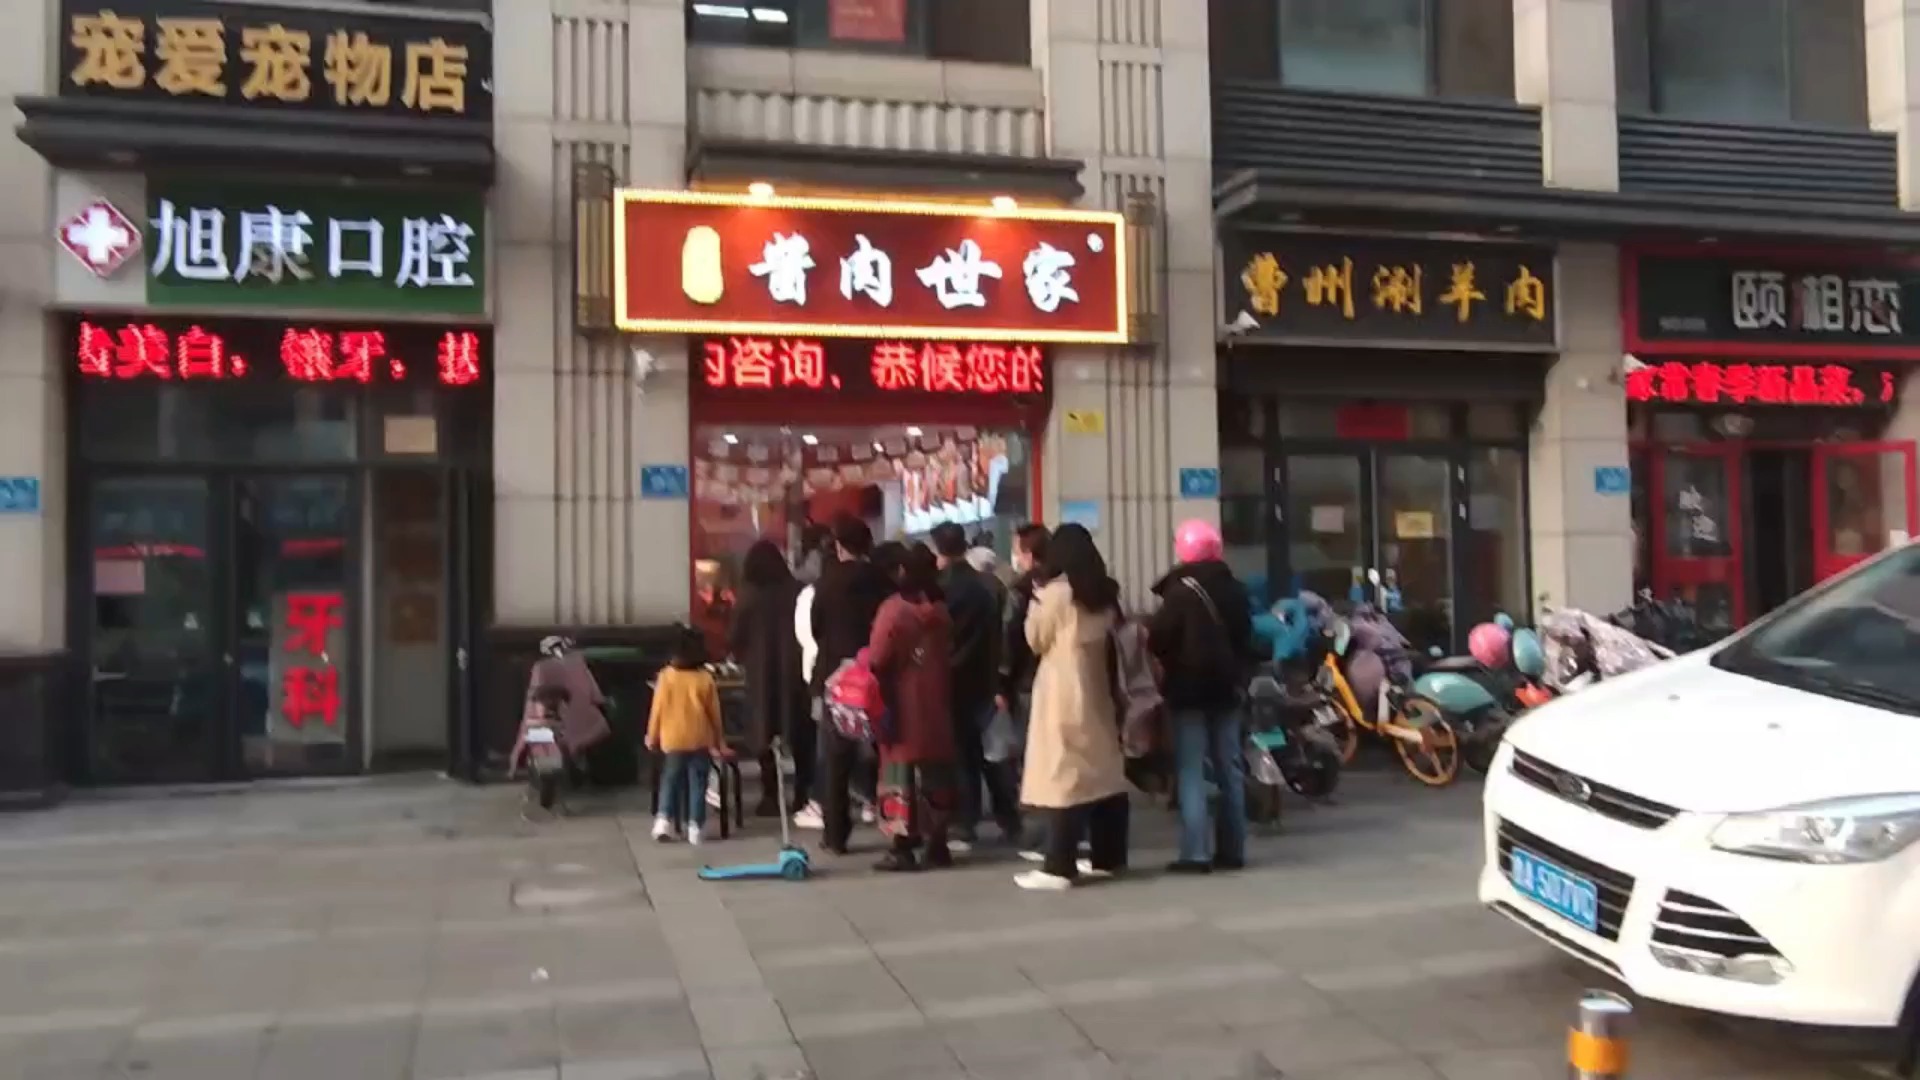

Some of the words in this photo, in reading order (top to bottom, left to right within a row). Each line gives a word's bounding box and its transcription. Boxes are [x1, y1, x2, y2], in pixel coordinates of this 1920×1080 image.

[70, 10, 469, 113] 宠爱宠物店
[149, 198, 475, 288] 旭康口腔
[748, 231, 1079, 312] 酱肉世家
[1241, 251, 1546, 322] 曹州涮羊肉
[1731, 270, 1902, 335] 颐相恋
[282, 592, 345, 729] 牙科
